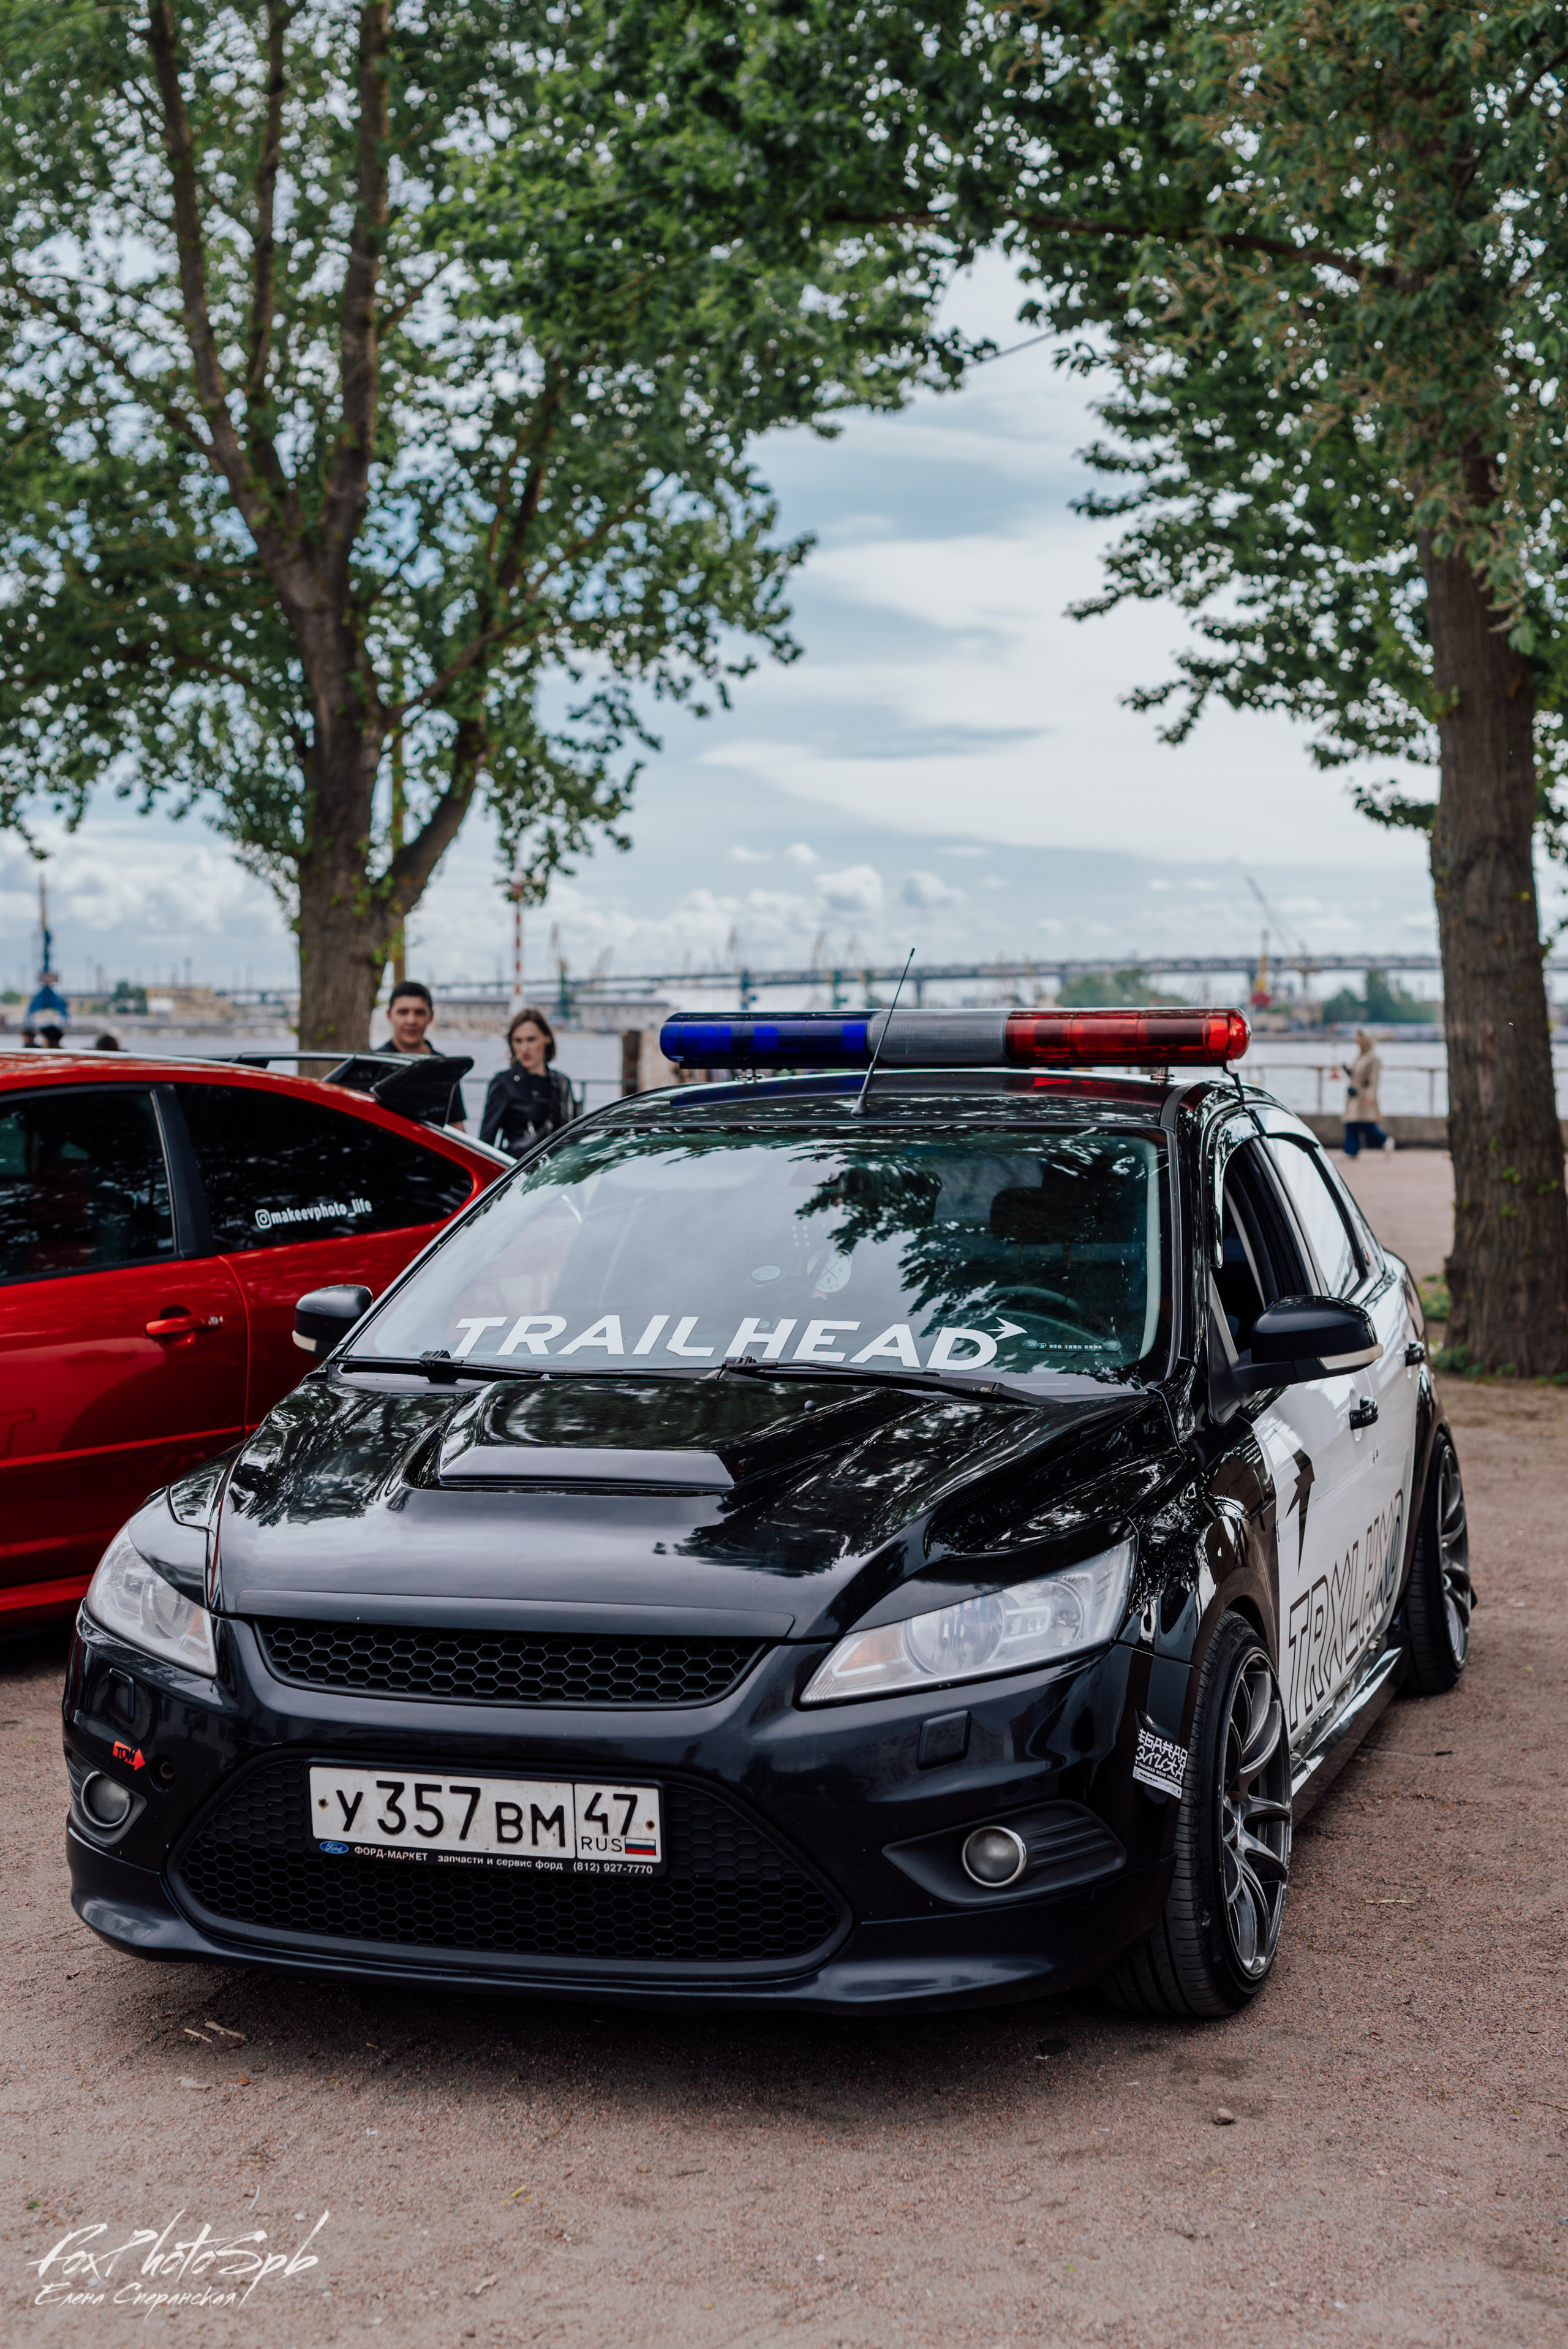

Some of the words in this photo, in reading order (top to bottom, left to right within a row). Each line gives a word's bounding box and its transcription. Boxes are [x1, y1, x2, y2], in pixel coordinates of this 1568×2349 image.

[271, 1198, 372, 1224] makeevphoto_life
[452, 1314, 997, 1371] TRAILHEAD
[117, 1747, 137, 1763] TOW
[584, 1793, 638, 1836] 47
[581, 1836, 623, 1852] RUS
[354, 1846, 428, 1861] ФОРД-МАРКЕТ
[438, 1855, 484, 1864] запчасти
[496, 1858, 532, 1867] сервис
[535, 1860, 563, 1870] форд
[573, 1861, 600, 1874] (812)
[603, 1863, 653, 1875] 927-7770
